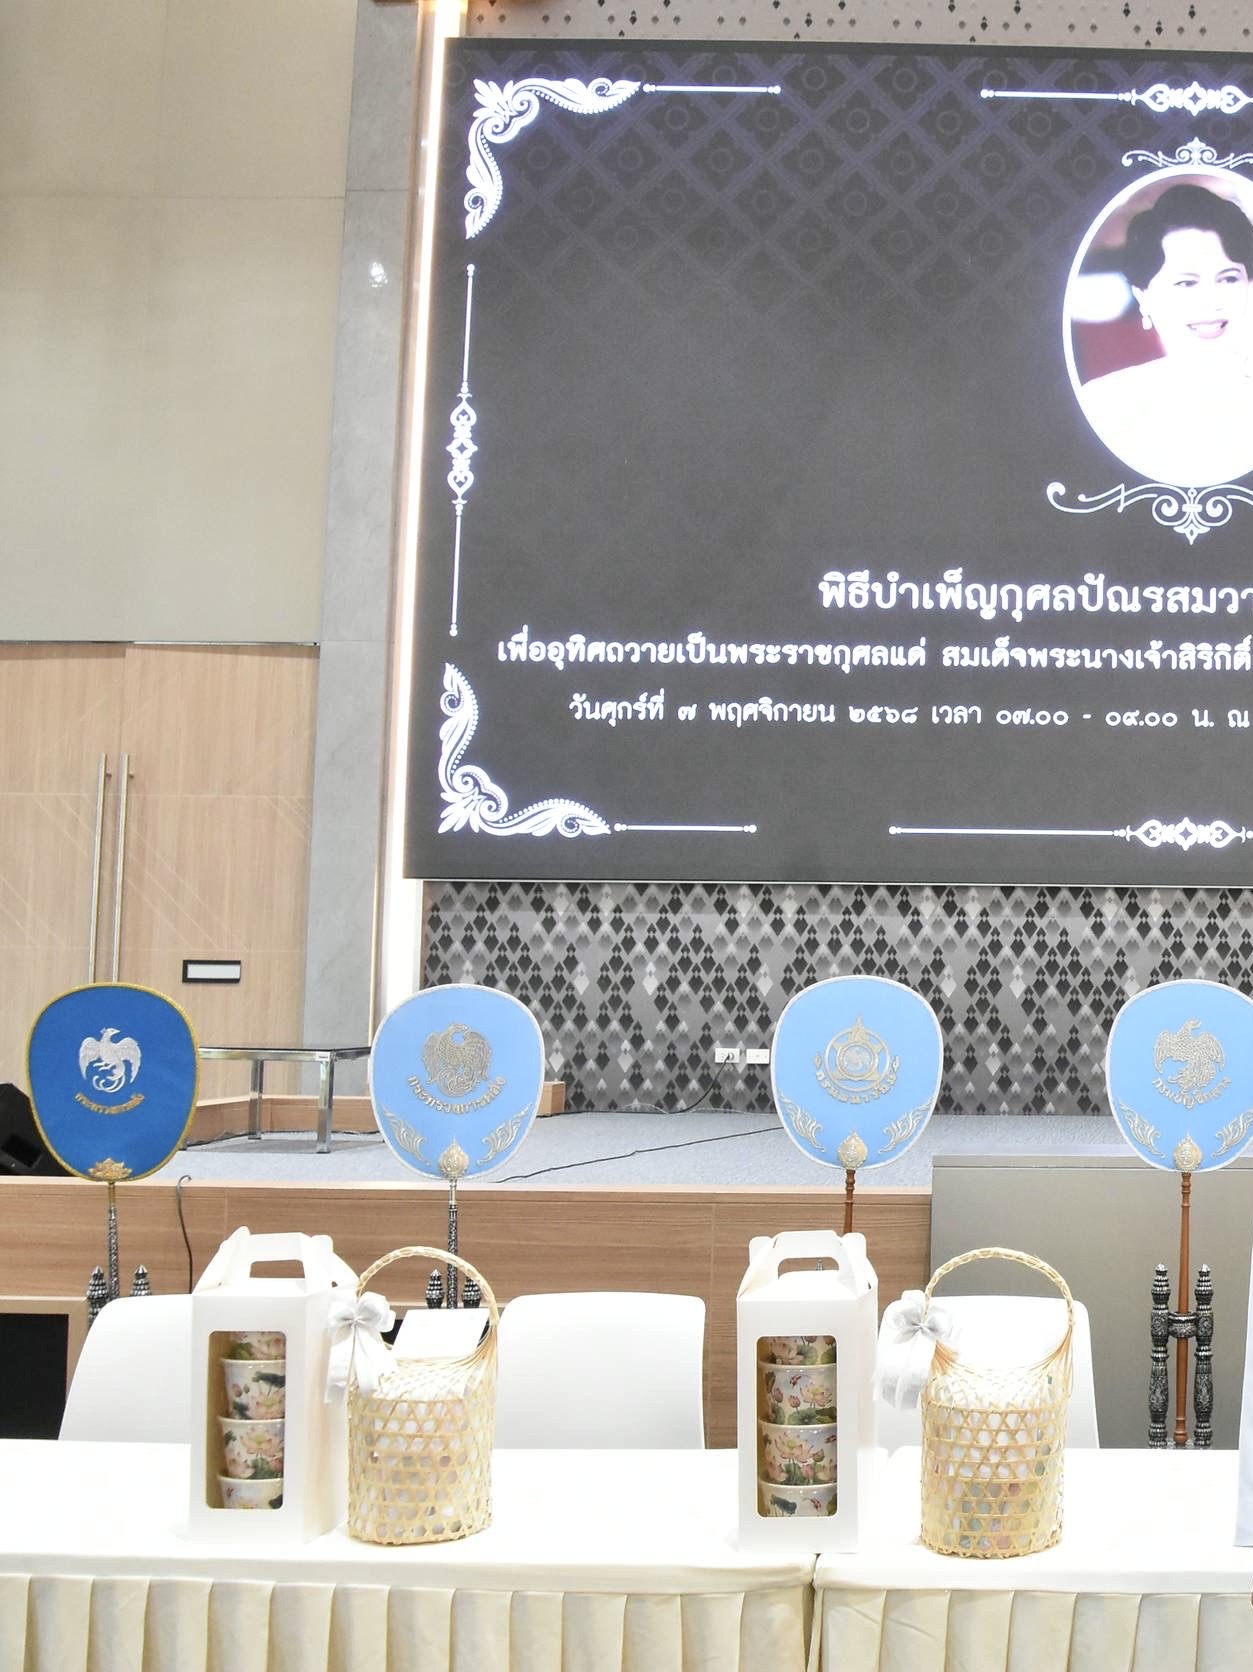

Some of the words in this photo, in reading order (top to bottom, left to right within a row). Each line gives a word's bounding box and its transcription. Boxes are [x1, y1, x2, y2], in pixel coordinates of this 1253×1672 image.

[497, 624, 926, 674] เพื่ออุทิศถวายเป็นพระราชกุศลแด่
[942, 634, 1253, 671] สมเด็จพระนางเจ้าสิริกิติ์
[568, 687, 665, 727] วันศุกร์ที่
[677, 703, 698, 721] ๗
[708, 696, 836, 728] พฤศจิกายน
[848, 705, 919, 724] ๒๕๖๘
[931, 705, 982, 724] เวลา
[995, 707, 1069, 726] ๐๗.๐๐
[1191, 708, 1215, 728] น.
[1227, 709, 1250, 728] ณ
